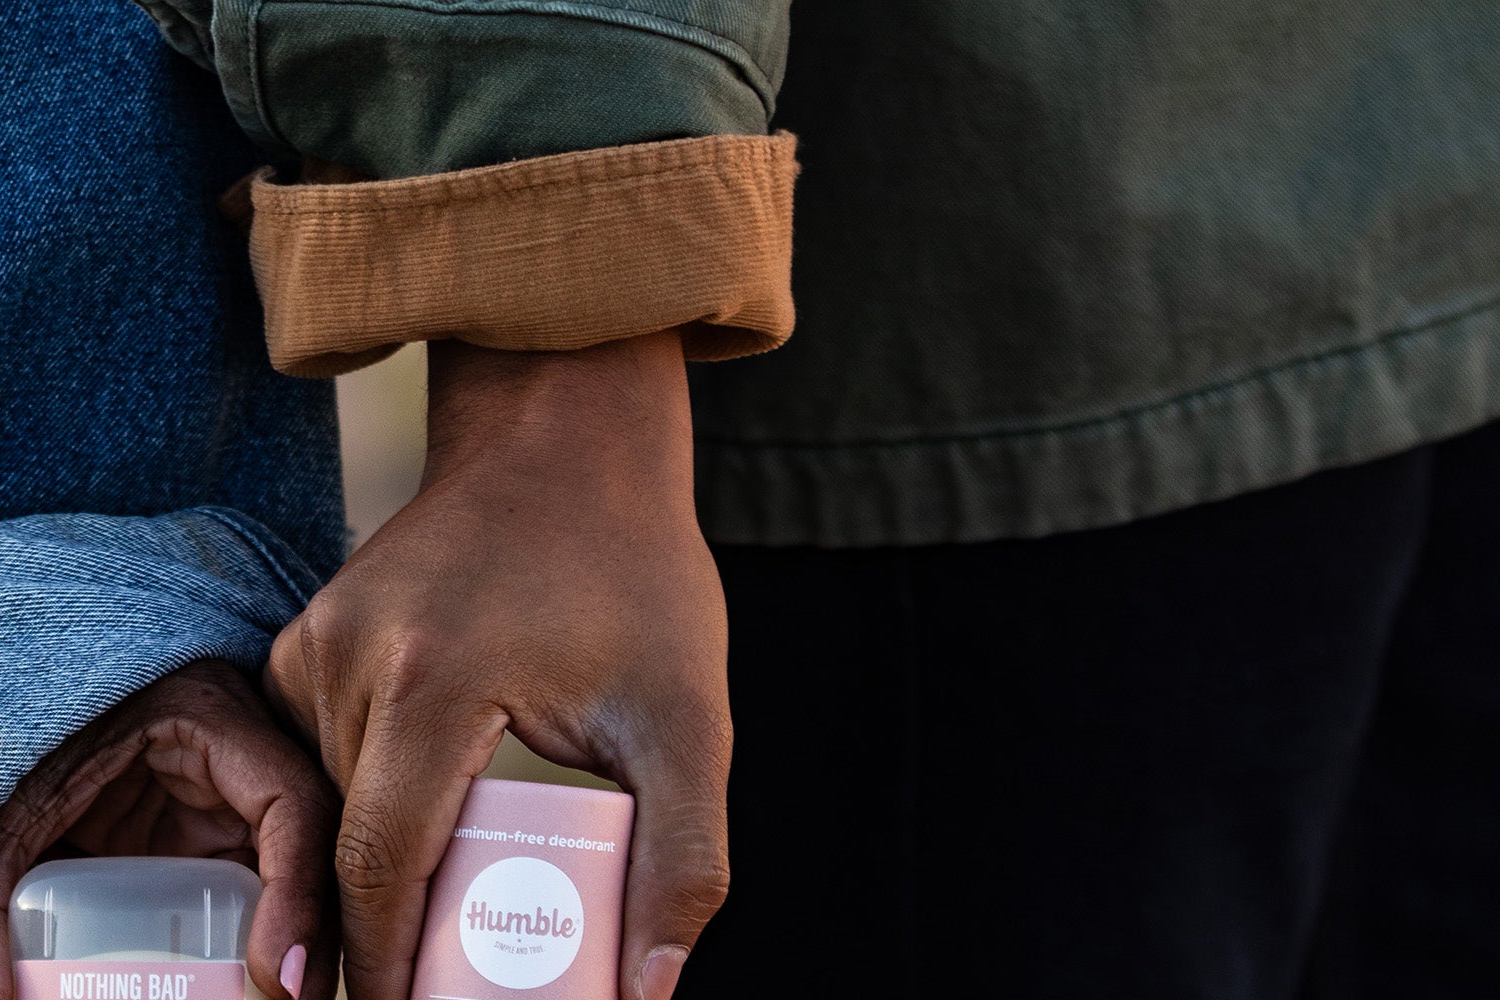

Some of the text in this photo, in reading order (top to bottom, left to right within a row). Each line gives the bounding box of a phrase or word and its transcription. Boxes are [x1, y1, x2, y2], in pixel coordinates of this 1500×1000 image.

[453, 825, 616, 853] uminum-free deodorant
[467, 901, 577, 939] Humble
[493, 940, 516, 954] SIMPLE
[515, 947, 530, 955] AND
[60, 972, 142, 1000] NOTHING
